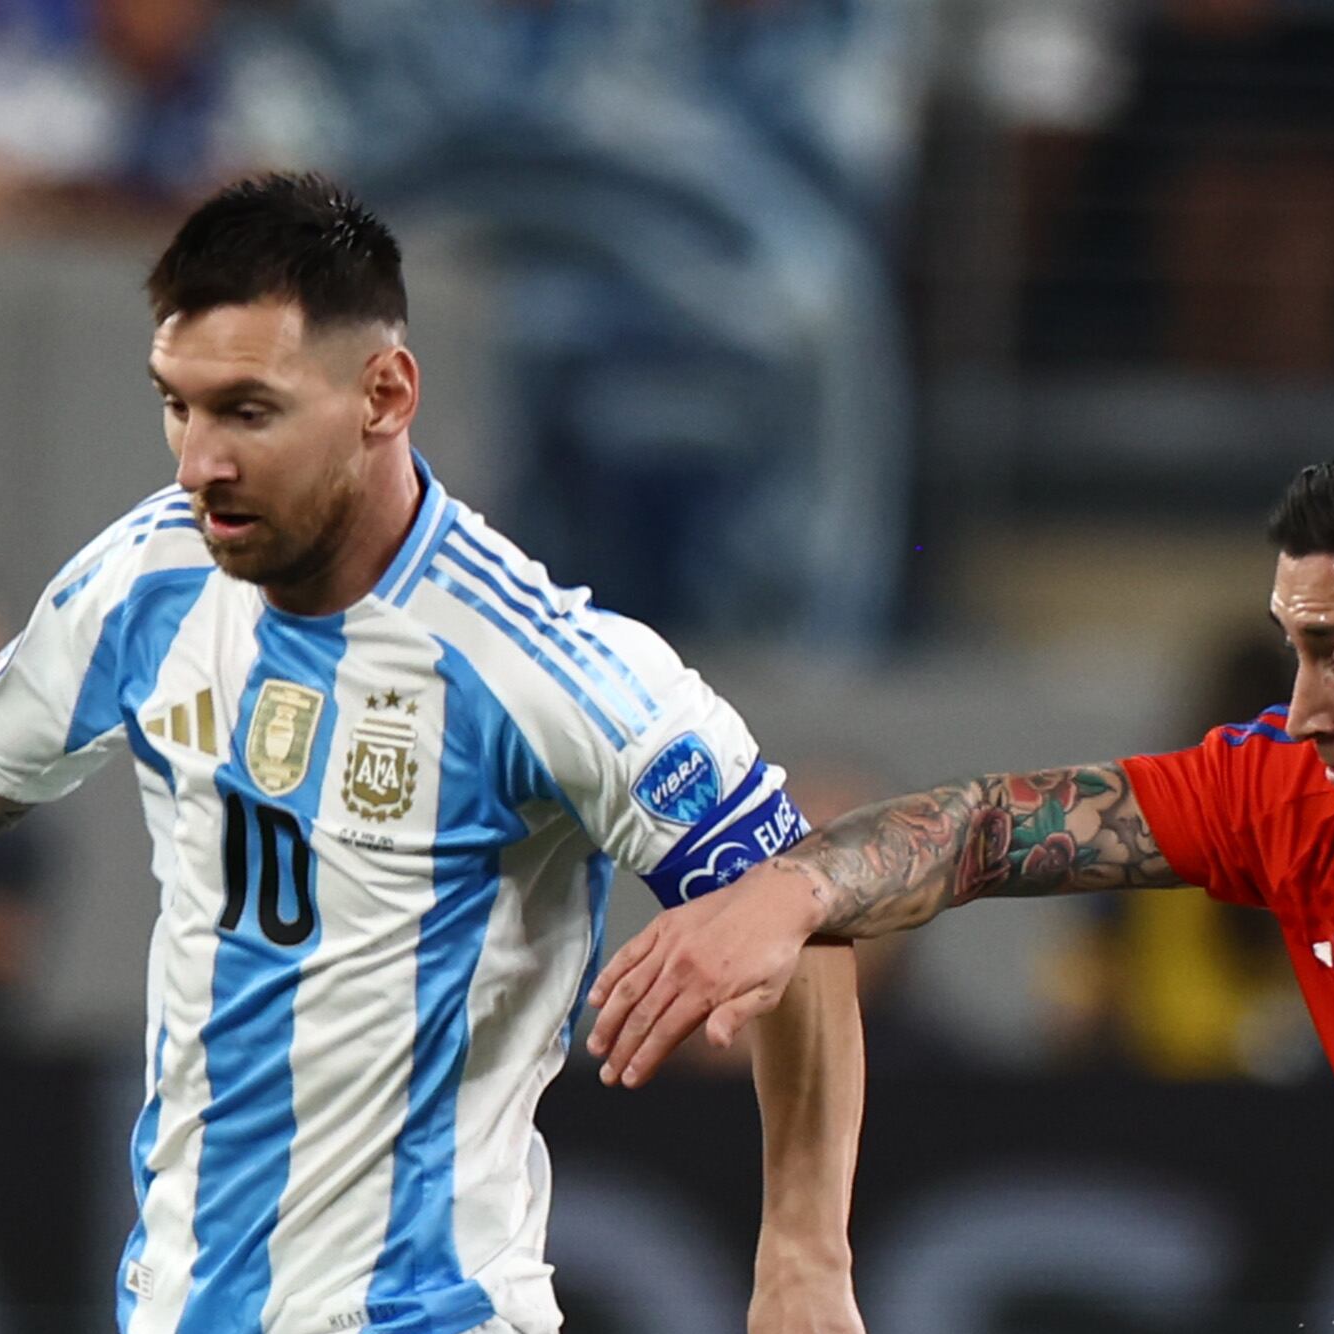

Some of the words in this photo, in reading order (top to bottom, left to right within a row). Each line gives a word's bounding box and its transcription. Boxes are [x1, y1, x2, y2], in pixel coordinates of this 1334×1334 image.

[355, 743, 400, 797] AFA
[651, 749, 705, 805] VIBRA
[220, 790, 314, 946] 10
